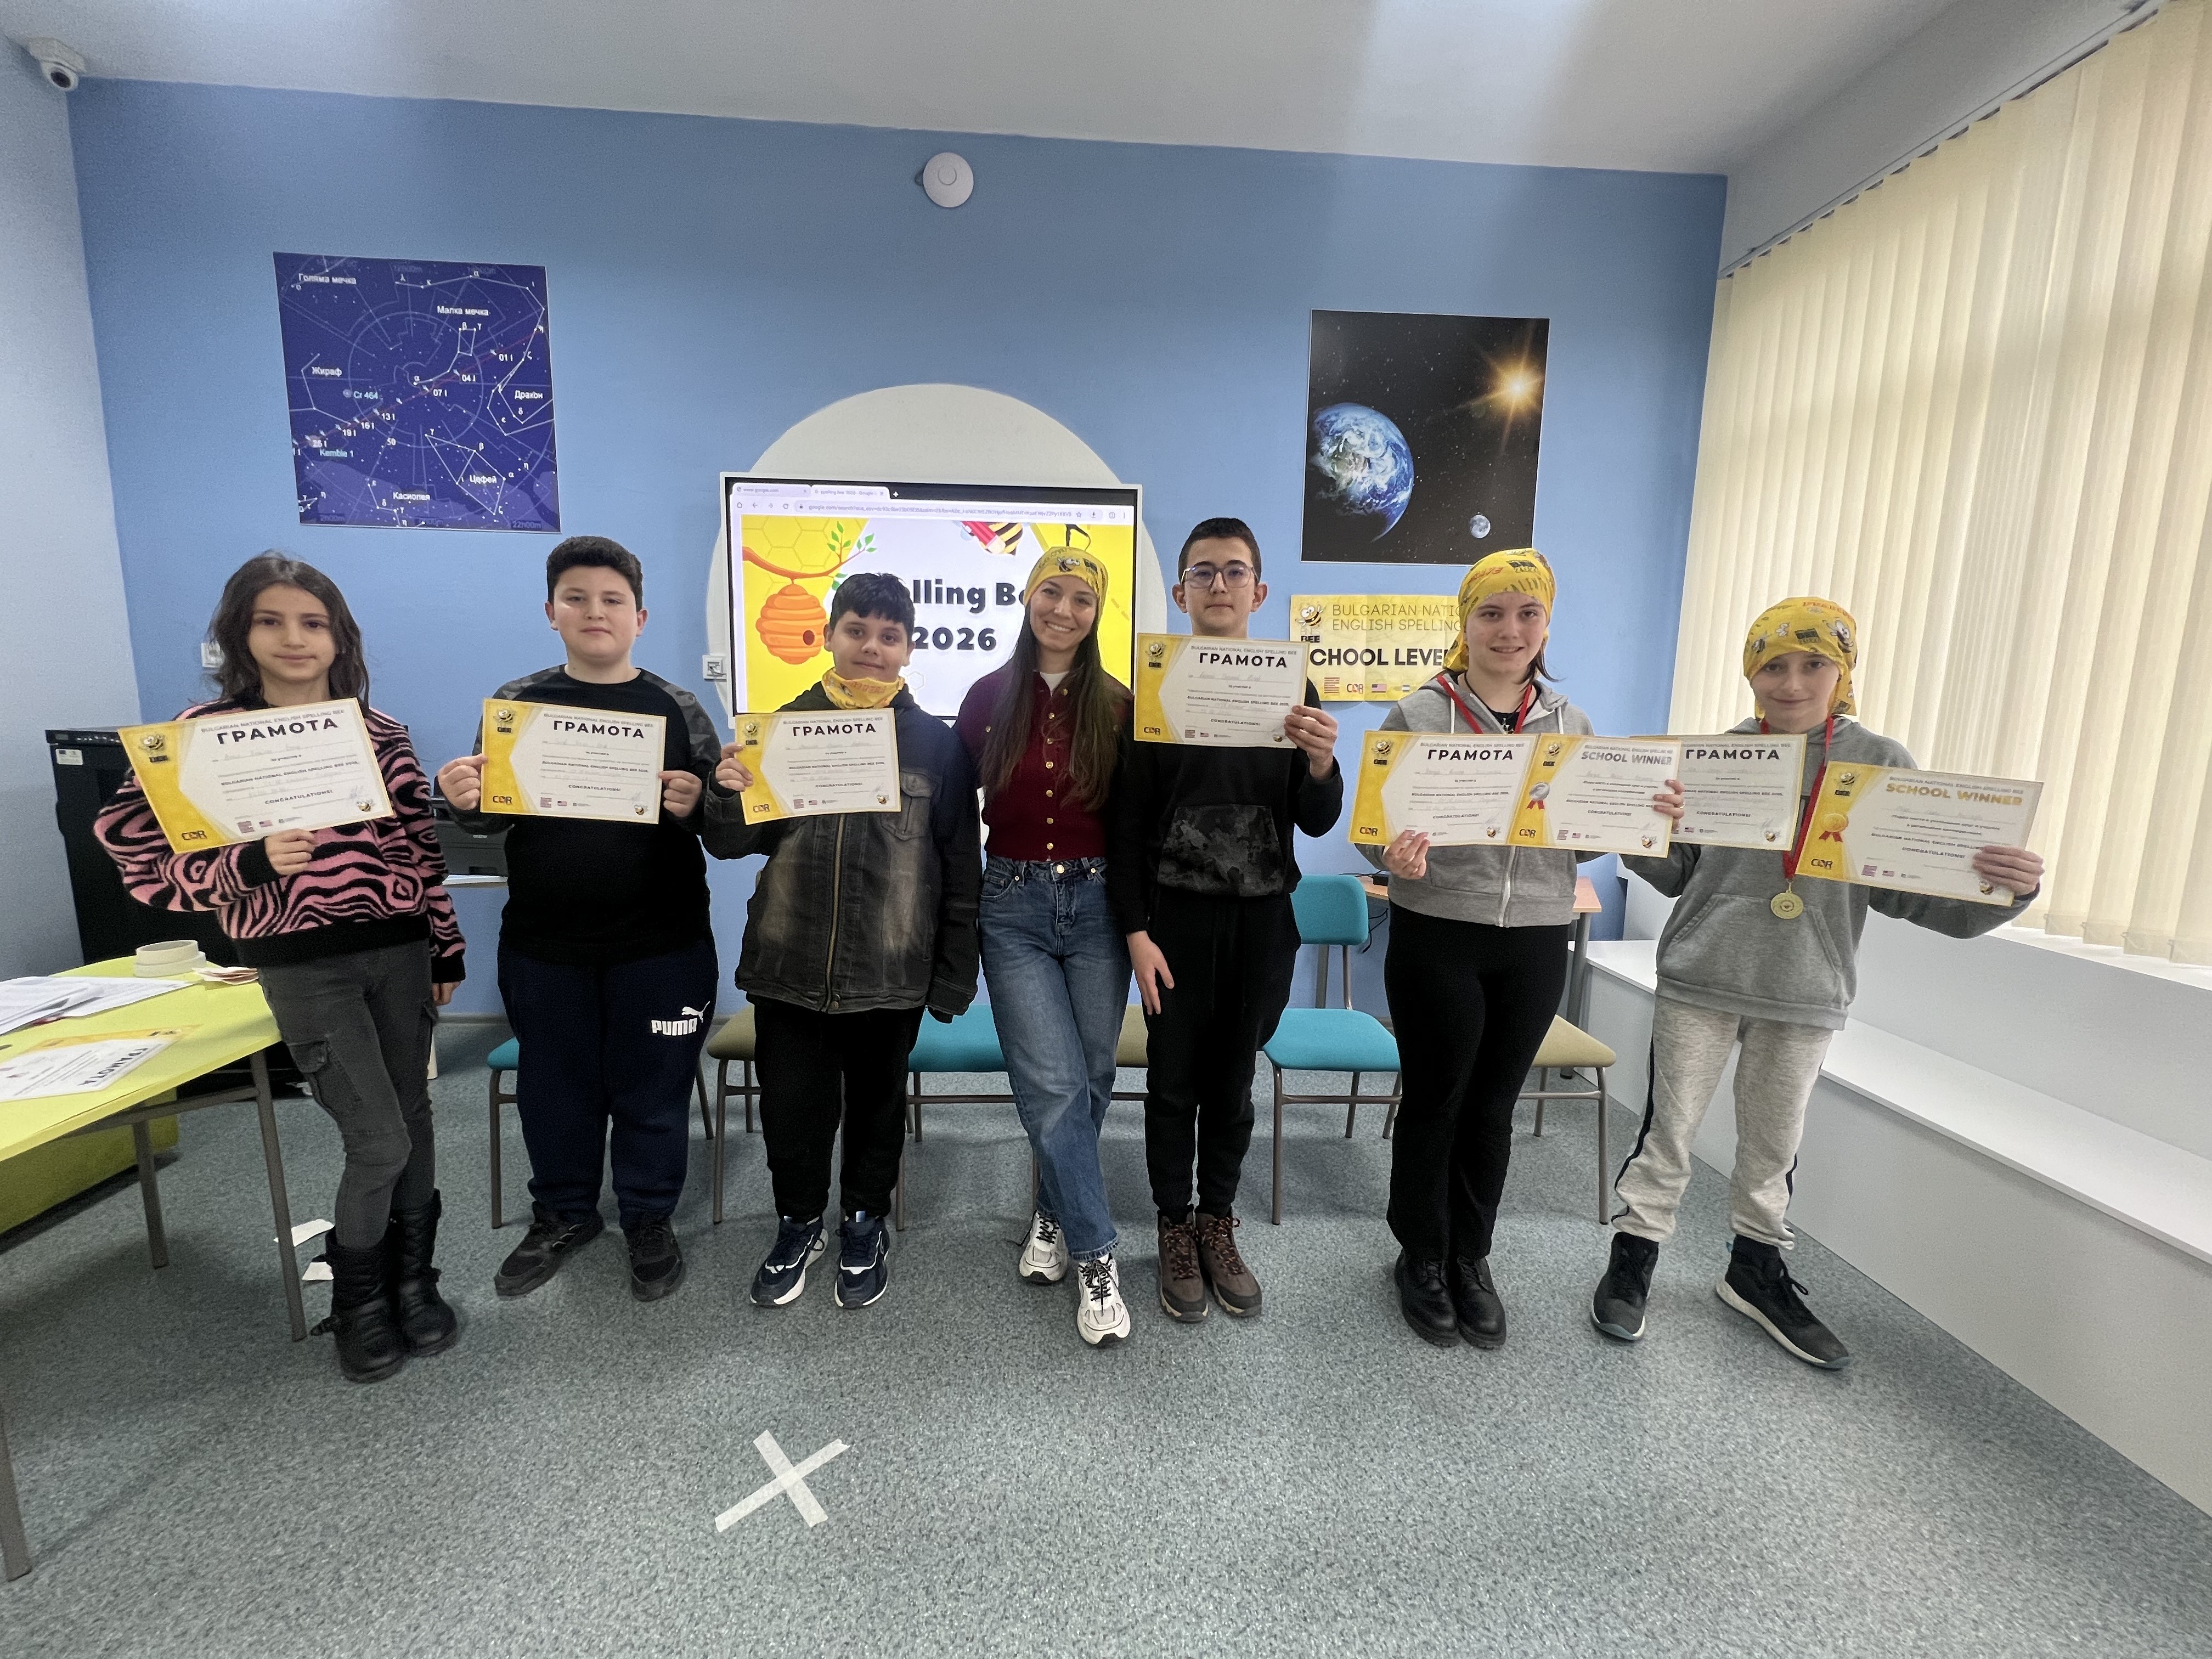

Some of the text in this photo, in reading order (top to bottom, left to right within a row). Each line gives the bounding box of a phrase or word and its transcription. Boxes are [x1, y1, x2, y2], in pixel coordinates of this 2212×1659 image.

[298, 273, 329, 283] Голяма
[437, 306, 462, 314] Малка
[312, 367, 342, 377] Жираф
[515, 390, 543, 400] Дракон
[470, 475, 496, 483] Цефей
[913, 579, 985, 614] lling
[1333, 605, 1420, 616] BULGARIAN
[1333, 619, 1393, 630] ENGLISH
[914, 627, 996, 651] 2026
[1199, 653, 1286, 668] ГРАМОТА
[1310, 649, 1389, 665] CHOOL
[217, 718, 338, 744] ГРАМОТА
[554, 720, 644, 738] ГРАМОТА
[793, 723, 876, 736] ГРАМОТА
[1427, 749, 1513, 760] ГРАМОТА
[1581, 752, 1672, 765] SCHOOL WINNER
[1686, 749, 1780, 760] ГРАМОТА
[1886, 783, 2022, 805] SCHOOL WINNER
[651, 1018, 697, 1036] PUMA
